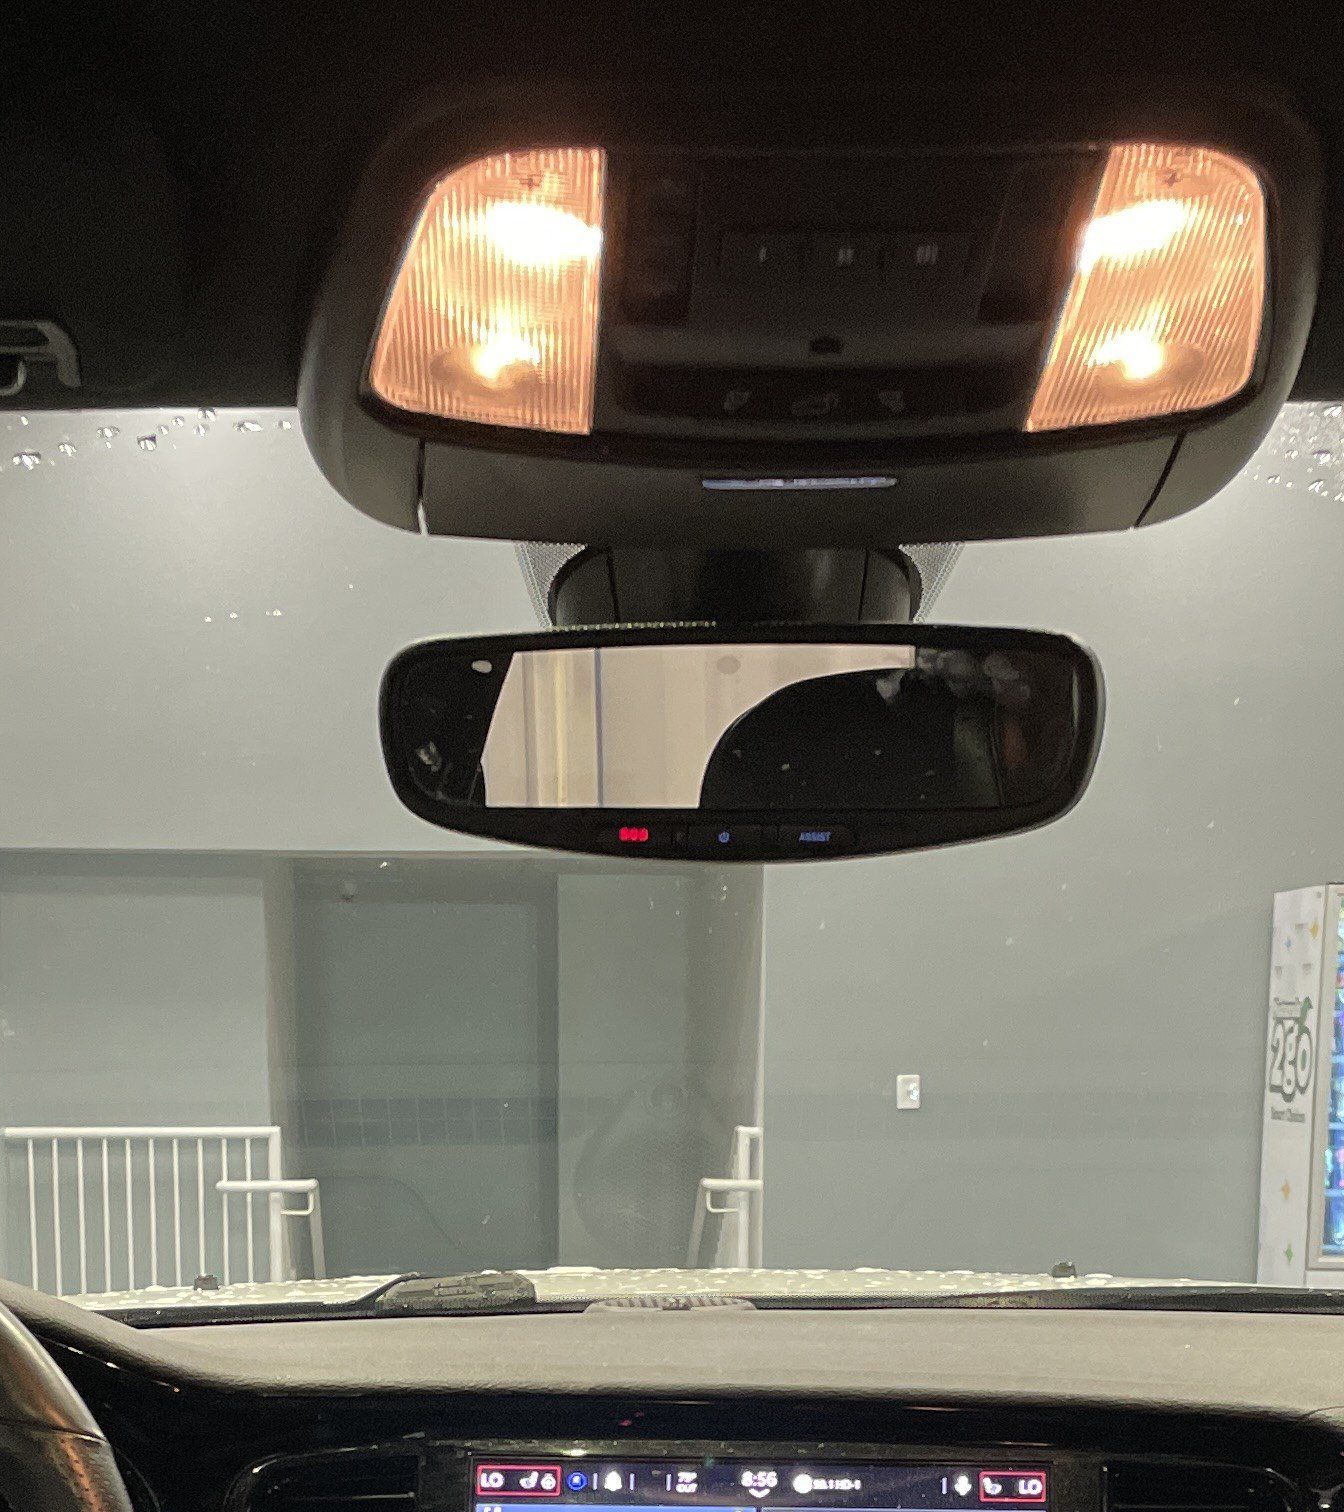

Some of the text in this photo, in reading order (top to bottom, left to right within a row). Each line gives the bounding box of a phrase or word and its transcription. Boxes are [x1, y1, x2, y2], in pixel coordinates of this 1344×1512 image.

[480, 1472, 505, 1488] LO
[741, 1471, 778, 1488] 8:56
[1018, 1479, 1043, 1495] LO
